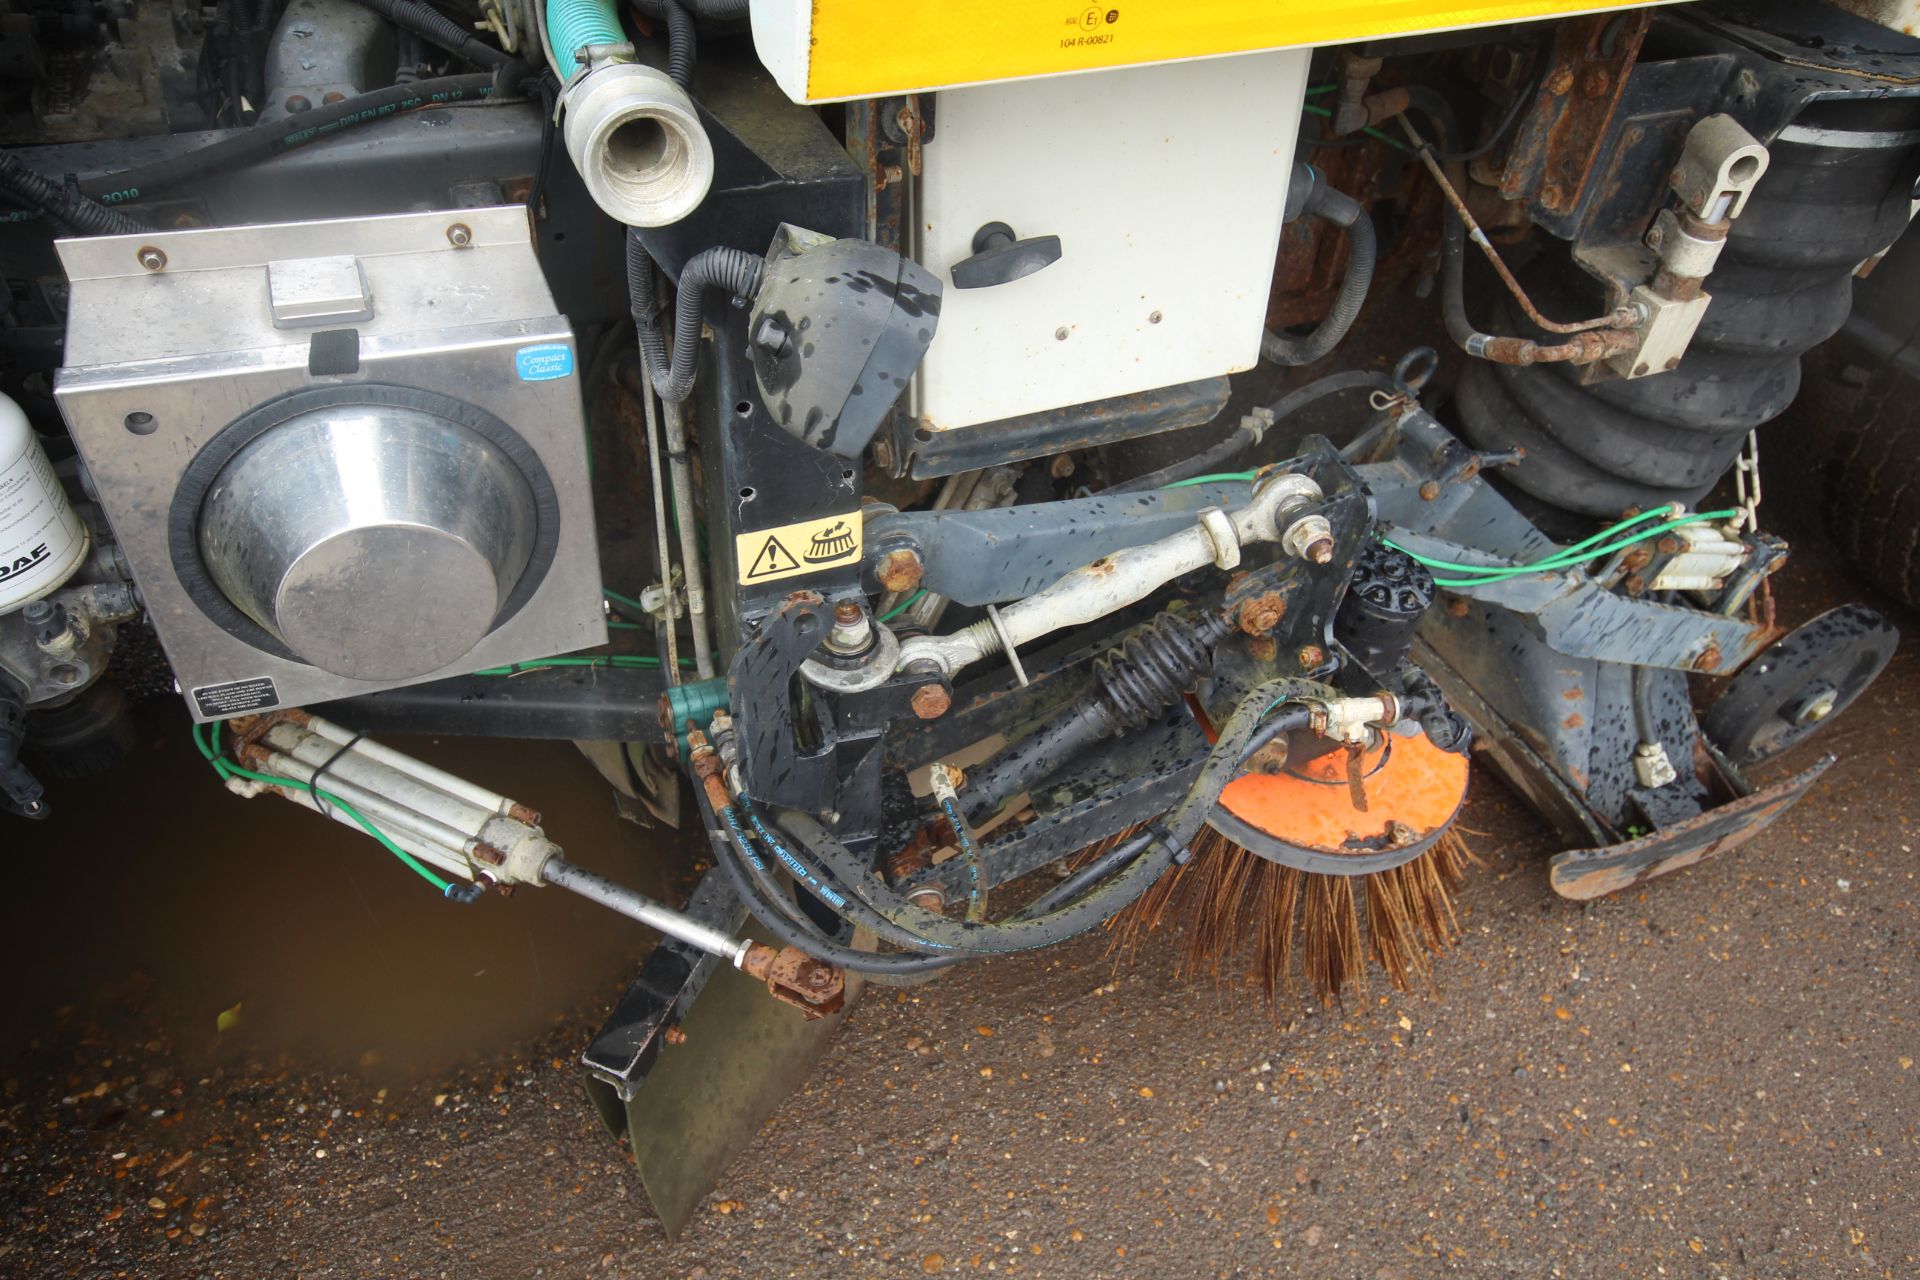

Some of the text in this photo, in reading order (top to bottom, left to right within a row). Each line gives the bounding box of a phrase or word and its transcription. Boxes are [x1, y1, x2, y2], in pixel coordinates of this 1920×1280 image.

[1060, 34, 1114, 48] 104 R-00821
[522, 352, 566, 366] Compact
[529, 363, 563, 375] Classic
